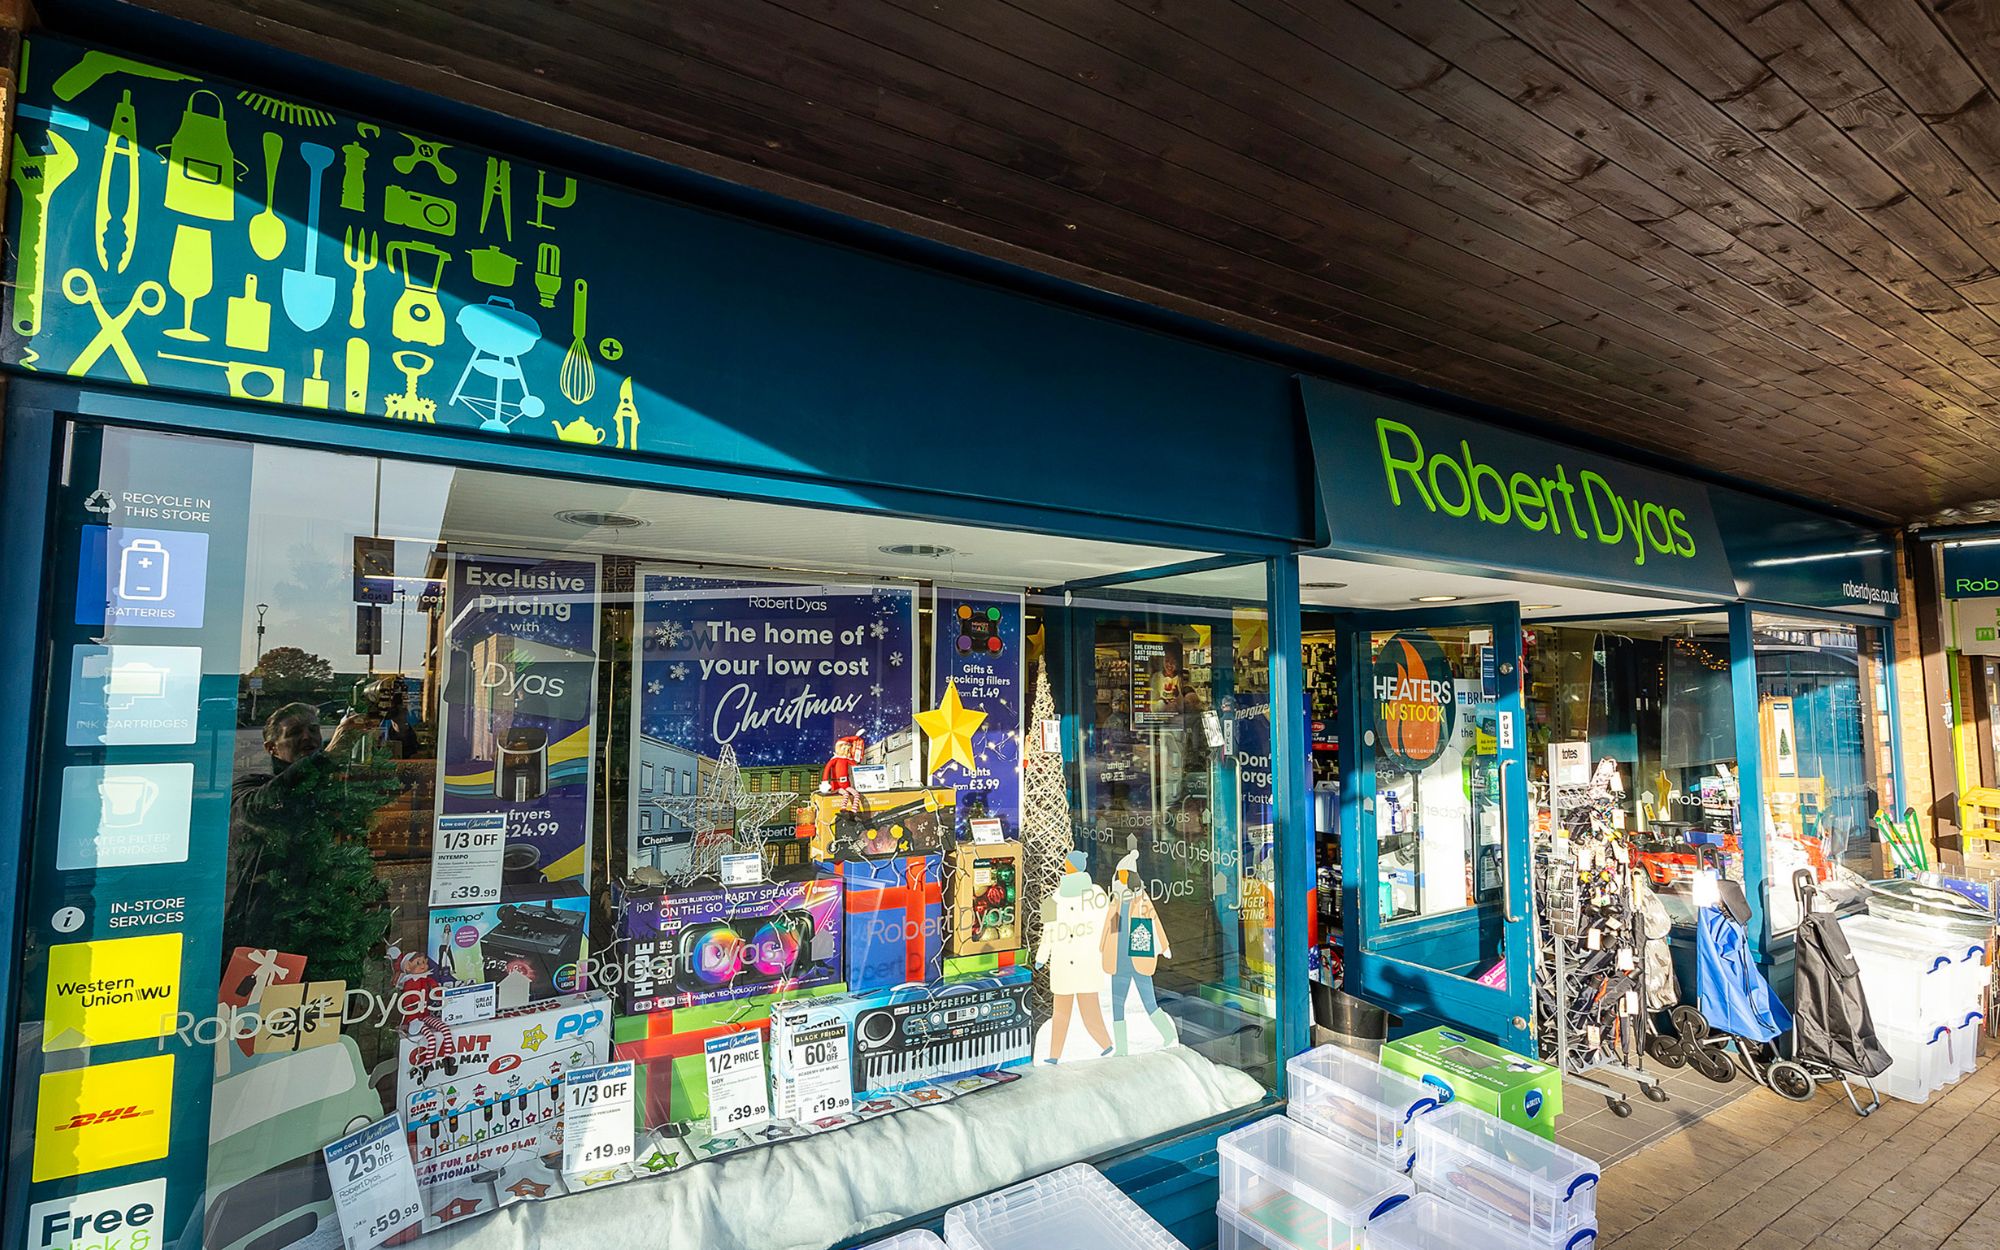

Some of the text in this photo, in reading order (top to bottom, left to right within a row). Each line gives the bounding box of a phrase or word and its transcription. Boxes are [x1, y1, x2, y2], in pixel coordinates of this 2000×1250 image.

[1375, 417, 1696, 566] Robert Dyas
[122, 492, 211, 509] RECYCLE IN
[125, 506, 210, 522] THIS STORE
[466, 566, 585, 592] Exclusive
[1842, 579, 1900, 605] robertdyas.co.uk
[479, 594, 572, 621] Pricing
[749, 595, 828, 612] Robert Dyas
[107, 607, 176, 618] BATTERIES
[510, 620, 540, 633] with
[706, 621, 757, 643] The
[764, 622, 835, 645] home
[843, 624, 865, 646] of
[700, 654, 869, 681] your low cost
[963, 665, 993, 674] Gifts &
[481, 661, 565, 698] Dyas
[986, 675, 1010, 686] fillers
[971, 687, 1000, 698] £1.49
[1373, 675, 1452, 704] HEATERS
[713, 682, 863, 745] Christmas
[1381, 702, 1445, 722] IN STOCK
[76, 719, 188, 729] INK CARTRIDGES
[1502, 715, 1510, 745] PUSH
[1461, 728, 1473, 738] the
[1562, 748, 1578, 759] totes
[962, 767, 991, 778] Lights
[969, 779, 1000, 790] £3.99
[509, 809, 551, 825] fryers
[1163, 811, 1190, 827] Dyas
[443, 832, 498, 850] 1/3 OFF
[642, 834, 674, 846] Chemist
[450, 886, 497, 899] £39.99
[725, 891, 759, 903] PARTY
[760, 886, 806, 899] SPEAKER
[1081, 878, 1146, 912] Robert
[1150, 878, 1195, 904] Dyas
[111, 897, 185, 914] IN-STORE
[660, 902, 723, 918] ON THE GO
[752, 905, 769, 913] LIGHT
[109, 911, 184, 929] SERVICES
[434, 913, 482, 924] intempo
[866, 905, 1016, 945] Robert Dyas
[574, 940, 780, 991] Robert Dyas
[658, 967, 673, 979] 20
[57, 977, 134, 997] Western
[717, 986, 757, 997] TECHNOLOGY
[81, 985, 171, 1009] Union WU
[476, 1001, 492, 1009] VALUE
[158, 986, 446, 1050] Robert Dyas
[796, 1028, 844, 1043] BLACK FRIDAY
[460, 1053, 489, 1065] MAT
[709, 1049, 760, 1073] 1/2 PRICE
[805, 1041, 837, 1066] 60%
[826, 1053, 838, 1062] OFF
[572, 1082, 627, 1107] 1/3 OFF
[410, 1101, 437, 1113] GIANT
[728, 1104, 766, 1122] £39.99
[813, 1097, 850, 1113] £19.99
[69, 1105, 142, 1129] DHL
[328, 1147, 343, 1157] Low
[344, 1140, 358, 1150] cost
[466, 1149, 493, 1162] EASY
[495, 1146, 510, 1155] TO
[585, 1143, 631, 1161] £19.99
[345, 1139, 390, 1182] 25%
[378, 1152, 394, 1167] OFF
[339, 1180, 364, 1198] Robert
[364, 1174, 381, 1188] Dyas
[41, 1203, 154, 1247] Free
[369, 1203, 419, 1238] £59.99
